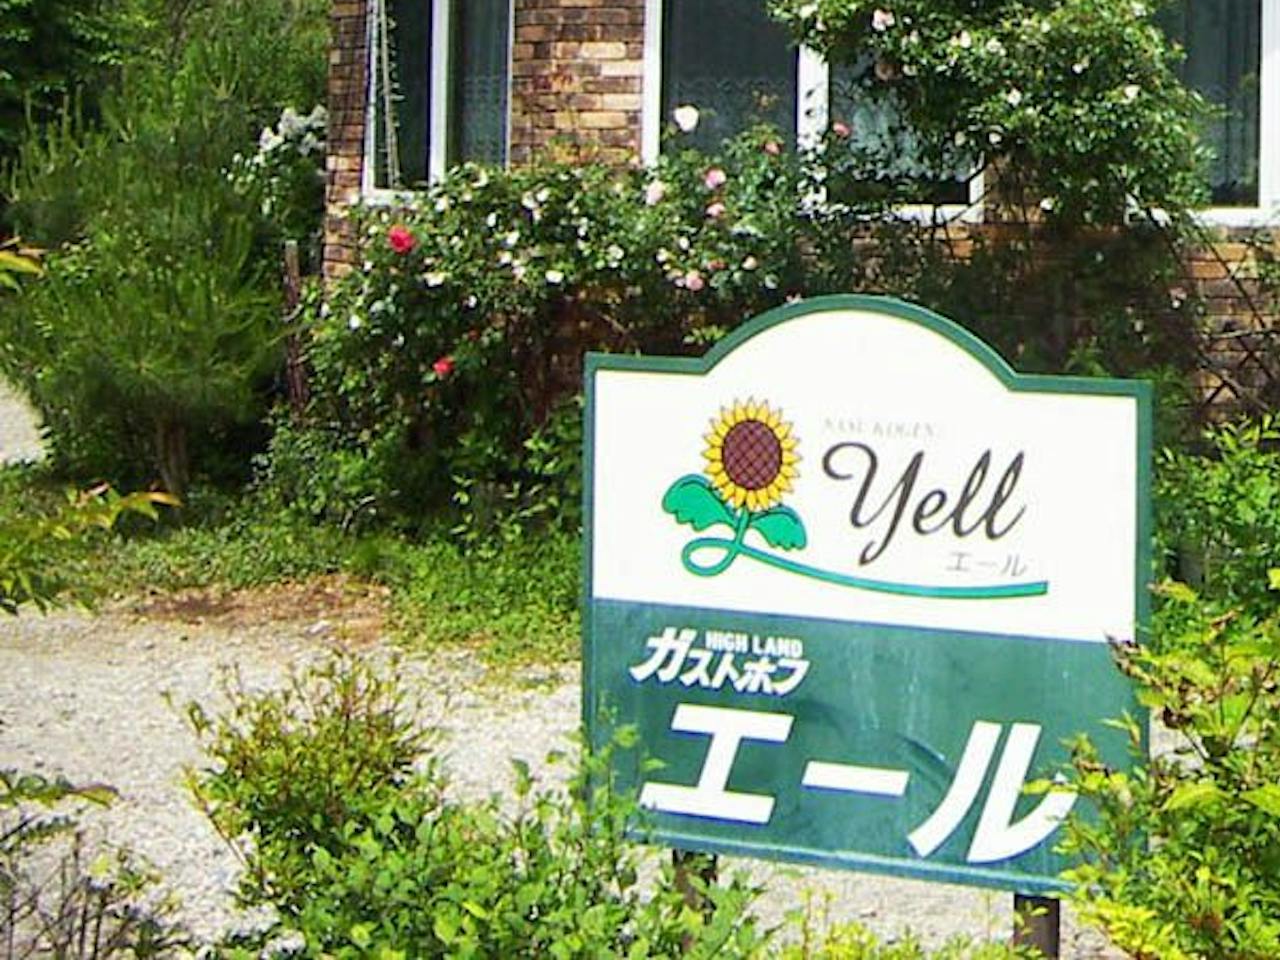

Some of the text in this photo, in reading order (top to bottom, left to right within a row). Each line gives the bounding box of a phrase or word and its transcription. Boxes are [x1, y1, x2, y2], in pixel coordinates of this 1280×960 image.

[822, 442, 1027, 566] Yell
[946, 551, 1028, 577] エール
[629, 626, 811, 696] ガストホフ
[705, 630, 804, 659] HIGH LAND
[638, 703, 1079, 864] エール
